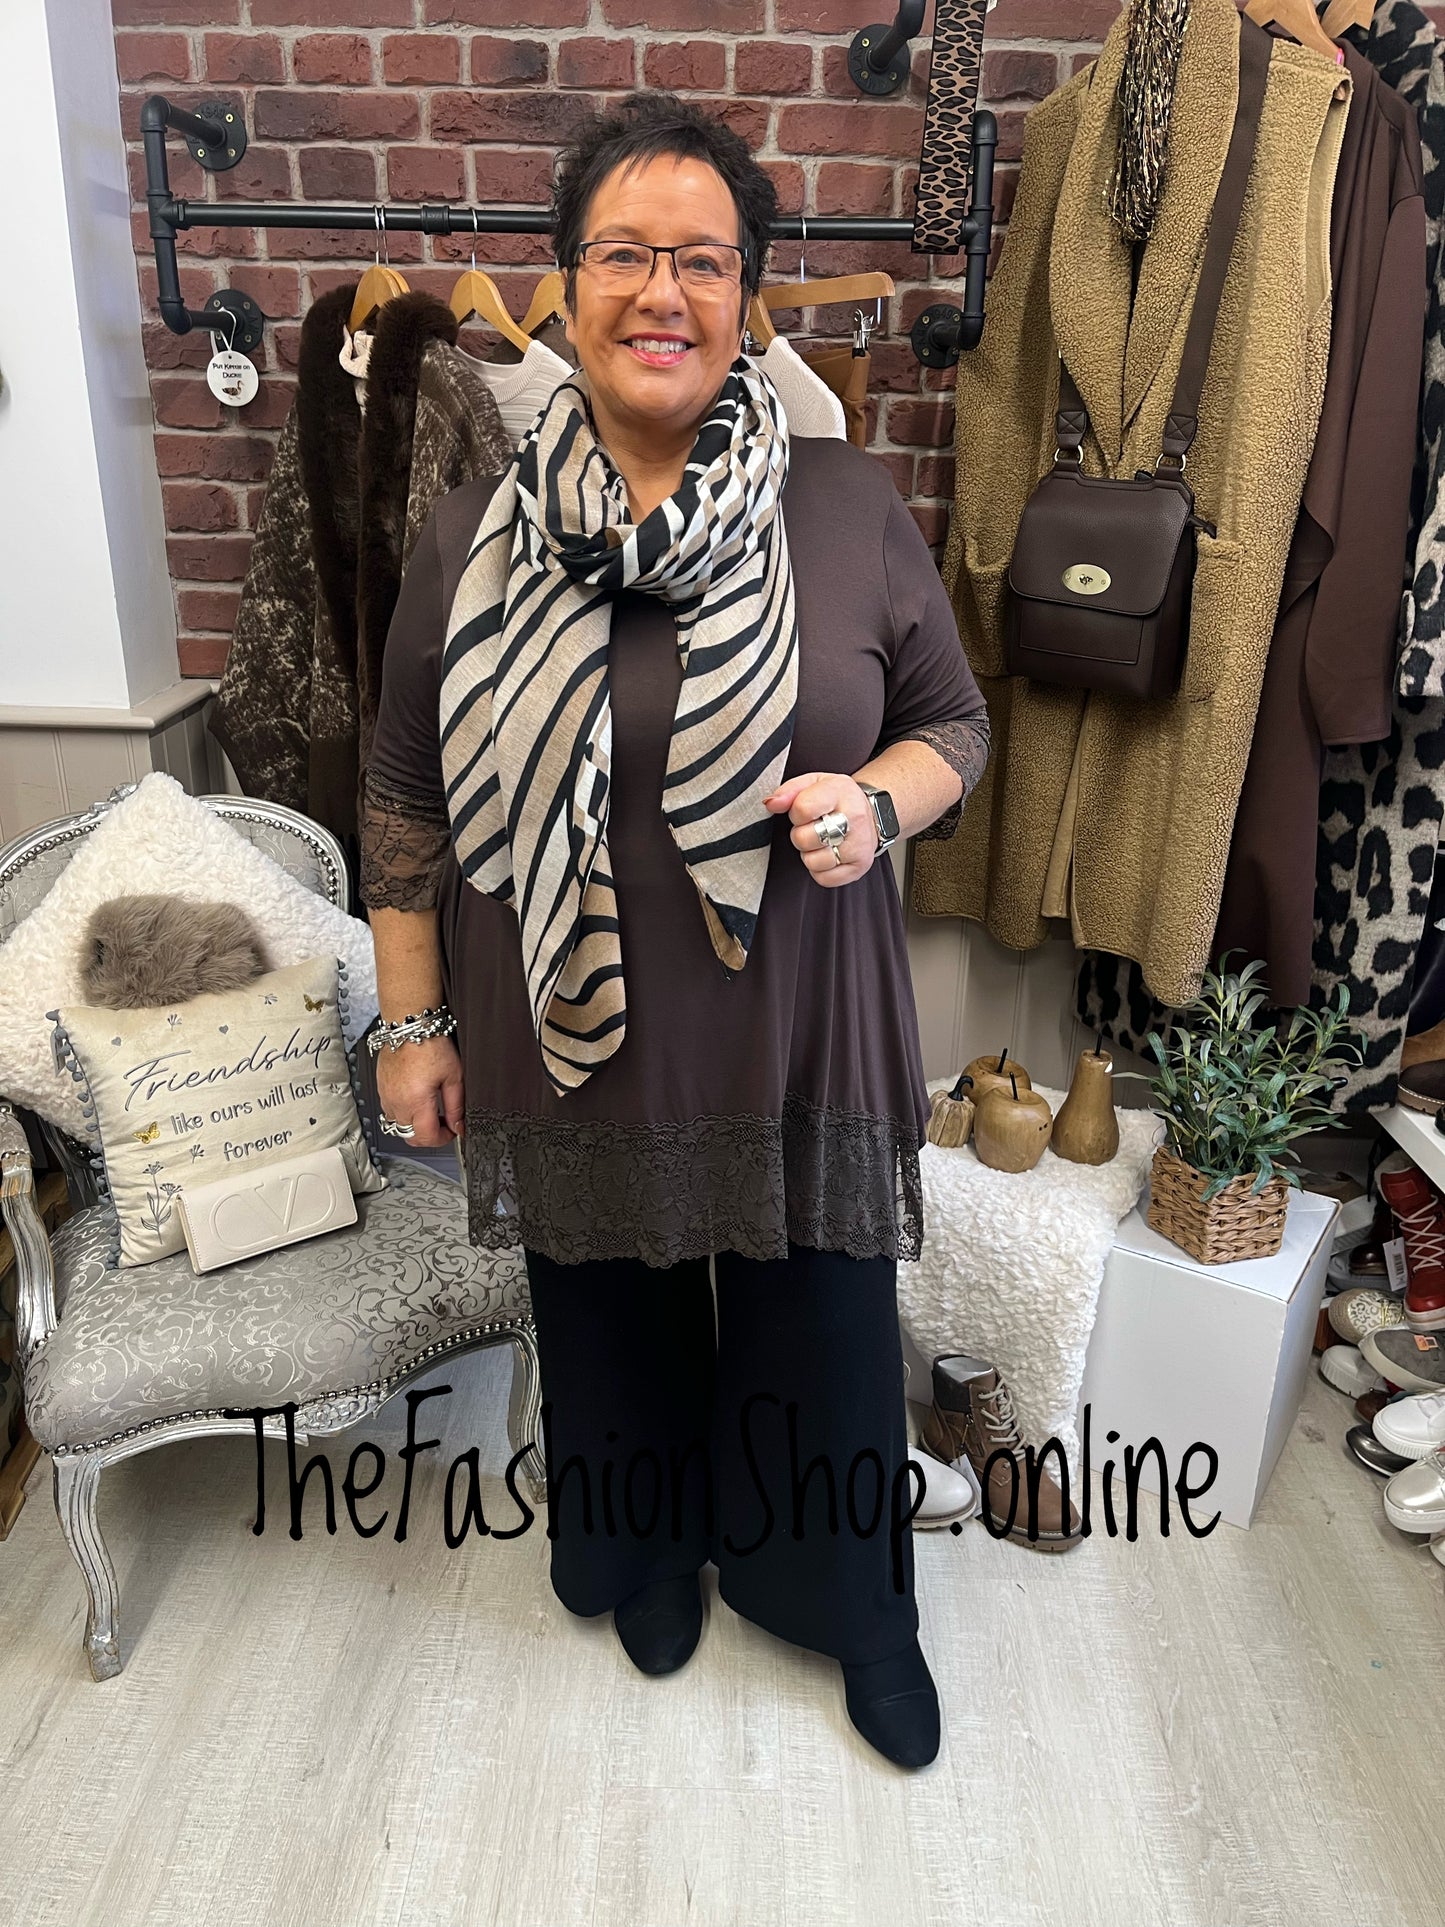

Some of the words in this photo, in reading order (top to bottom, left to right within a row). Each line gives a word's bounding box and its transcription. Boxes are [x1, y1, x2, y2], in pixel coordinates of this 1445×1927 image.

[123, 1028, 330, 1111] Friendship
[171, 1112, 204, 1135] like
[210, 1100, 253, 1124] ours
[258, 1086, 285, 1110] will
[289, 1077, 319, 1101] last
[223, 1129, 293, 1162] forever
